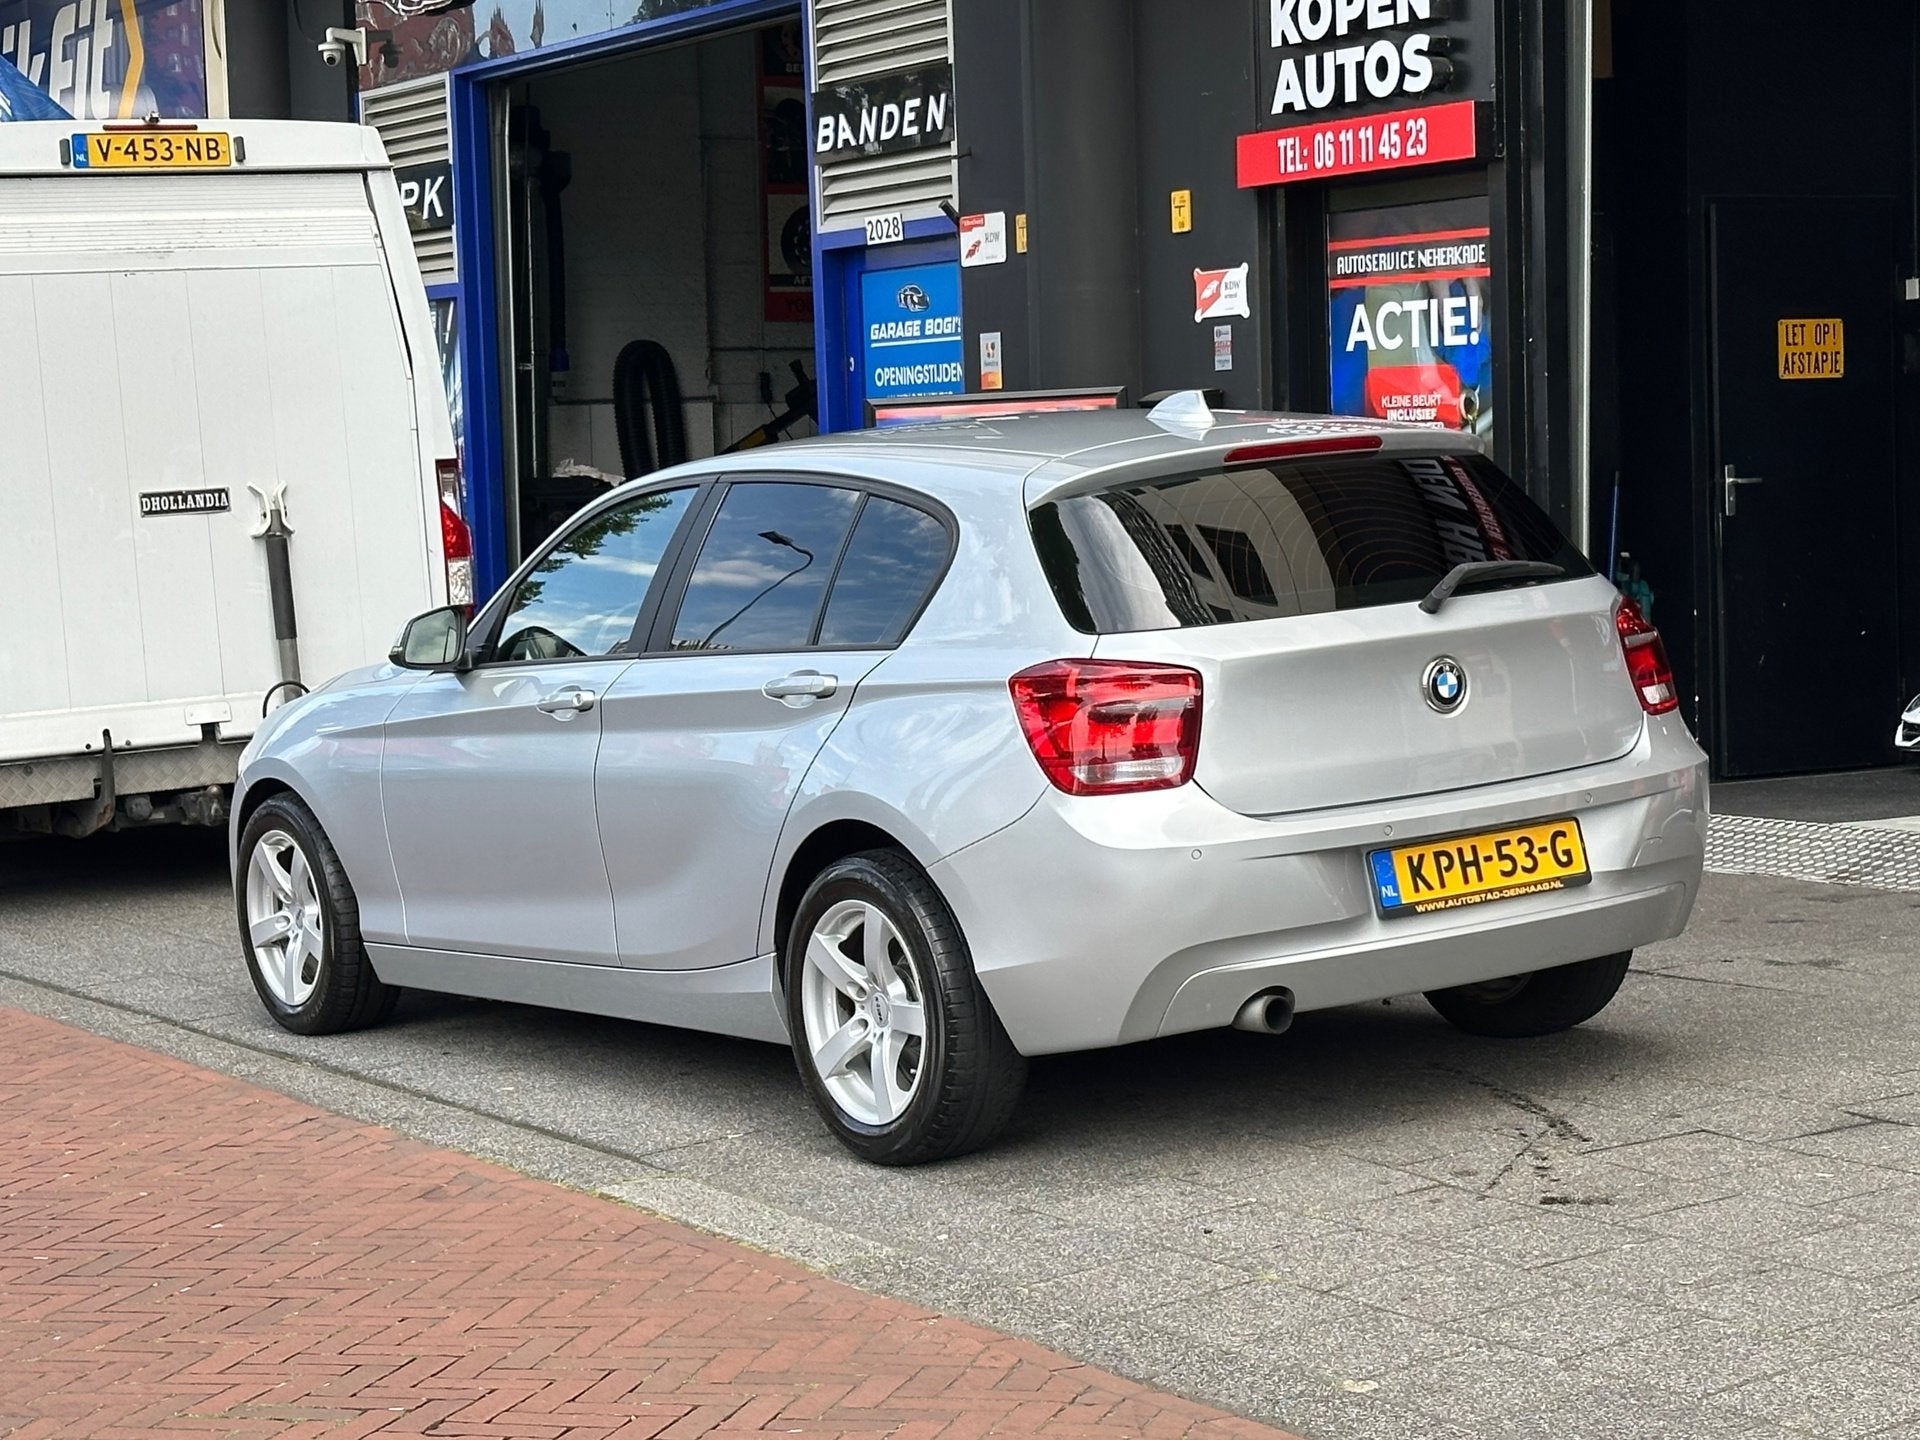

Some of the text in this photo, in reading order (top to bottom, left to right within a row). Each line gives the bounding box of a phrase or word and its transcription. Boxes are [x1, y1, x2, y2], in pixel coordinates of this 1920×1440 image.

[1271, 34, 1433, 115] AUTOS
[817, 93, 947, 152] BANDEN
[76, 153, 87, 162] NL
[96, 137, 221, 162] V-453-NB
[1277, 117, 1428, 174] TEL: 06 11 11 45 23
[867, 216, 900, 241] 2028
[1418, 244, 1486, 268] NEHERKADE
[1224, 280, 1240, 291] RDW
[870, 320, 921, 340] GARAGE
[1345, 295, 1480, 352] ACTIE!
[1785, 323, 1806, 346] LET
[1783, 351, 1841, 375] AFSTAPJE
[1381, 391, 1443, 409] KLEINE BEURT
[1386, 407, 1437, 421] INCLUSIEF
[141, 491, 229, 512] DHOLLANDIA
[1406, 829, 1574, 894] KPH-53-G
[1382, 883, 1398, 898] NL
[1415, 880, 1564, 913] WWW.AUTOSTAD-DENHAAG.NL
